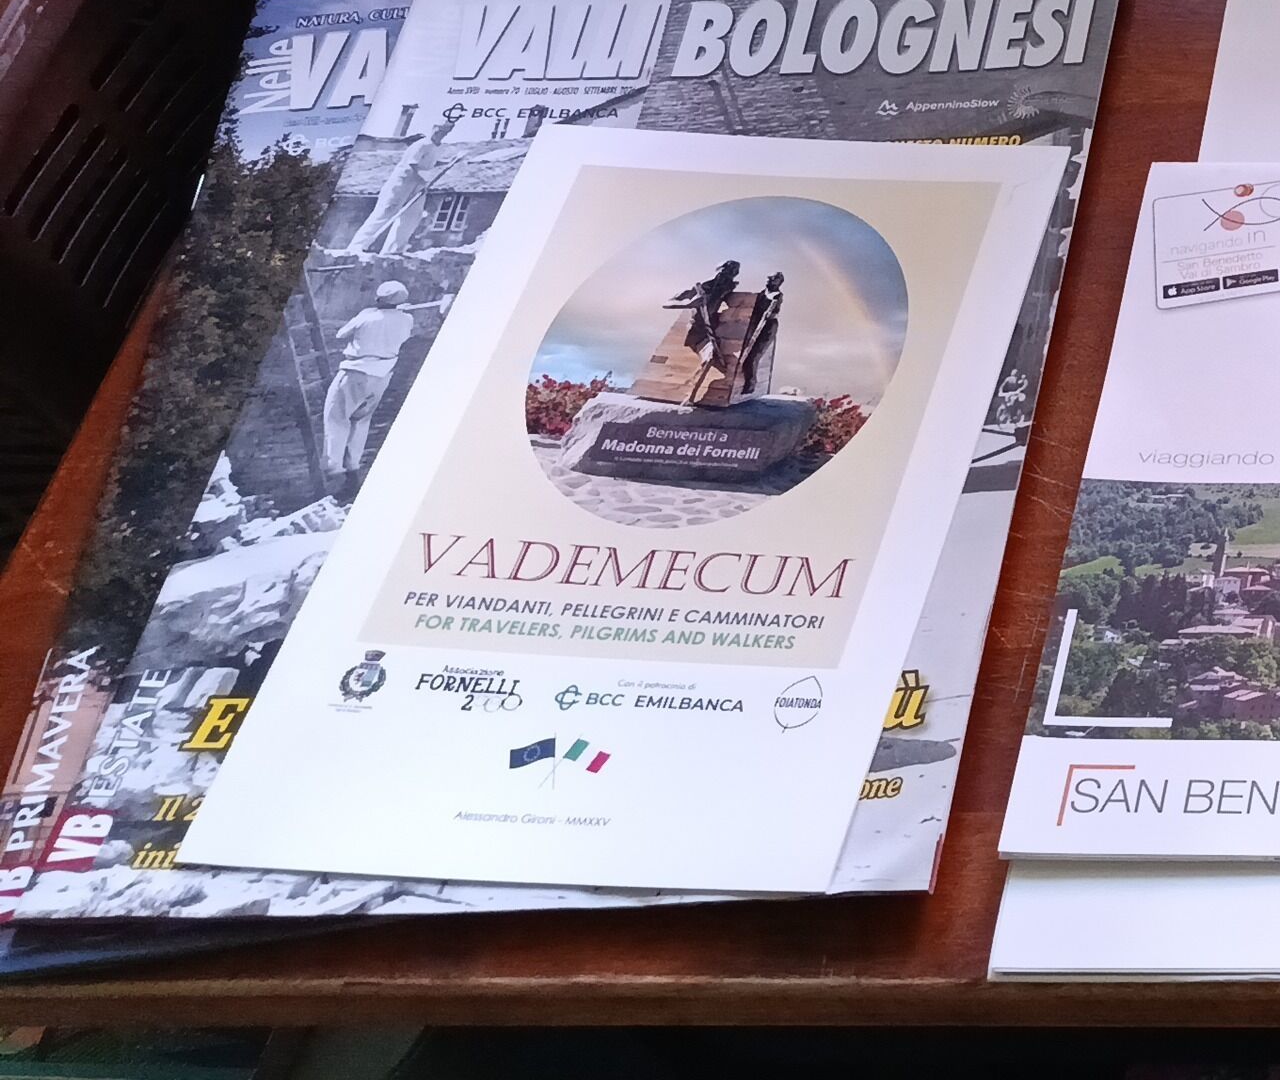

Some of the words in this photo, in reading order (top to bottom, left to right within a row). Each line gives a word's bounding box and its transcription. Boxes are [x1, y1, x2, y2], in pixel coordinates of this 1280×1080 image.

[450, 2, 666, 80] VALLI
[239, 38, 295, 115] Nelle
[471, 108, 507, 119] BCC
[905, 98, 1000, 113] AppenninoSlow
[601, 438, 674, 456] Madonna
[676, 443, 700, 457] dei
[703, 445, 761, 460] Fornelli
[646, 426, 717, 442] Benvenuti
[718, 432, 729, 442] a
[1138, 450, 1275, 469] viaggiando
[418, 532, 857, 599] VADEMECUM
[403, 591, 439, 608] PER
[445, 594, 553, 617] VIANDANTI,
[560, 602, 665, 622] PELLEGRINI
[667, 609, 680, 622] E
[683, 609, 826, 630] CAMMINATORI
[414, 613, 456, 631] FOR
[459, 617, 563, 640] TRAVELERS,
[569, 624, 659, 643] PILGRIMS
[661, 629, 706, 645] AND
[711, 632, 796, 650] WALKERS
[414, 673, 520, 696] FORNELLI
[585, 693, 625, 707] BCC
[634, 694, 745, 712] EMILBANCA
[5, 645, 100, 853] PRIMAVERA
[87, 668, 173, 799] ESTATE
[1070, 777, 1169, 814] SAN
[46, 812, 115, 863] VB
